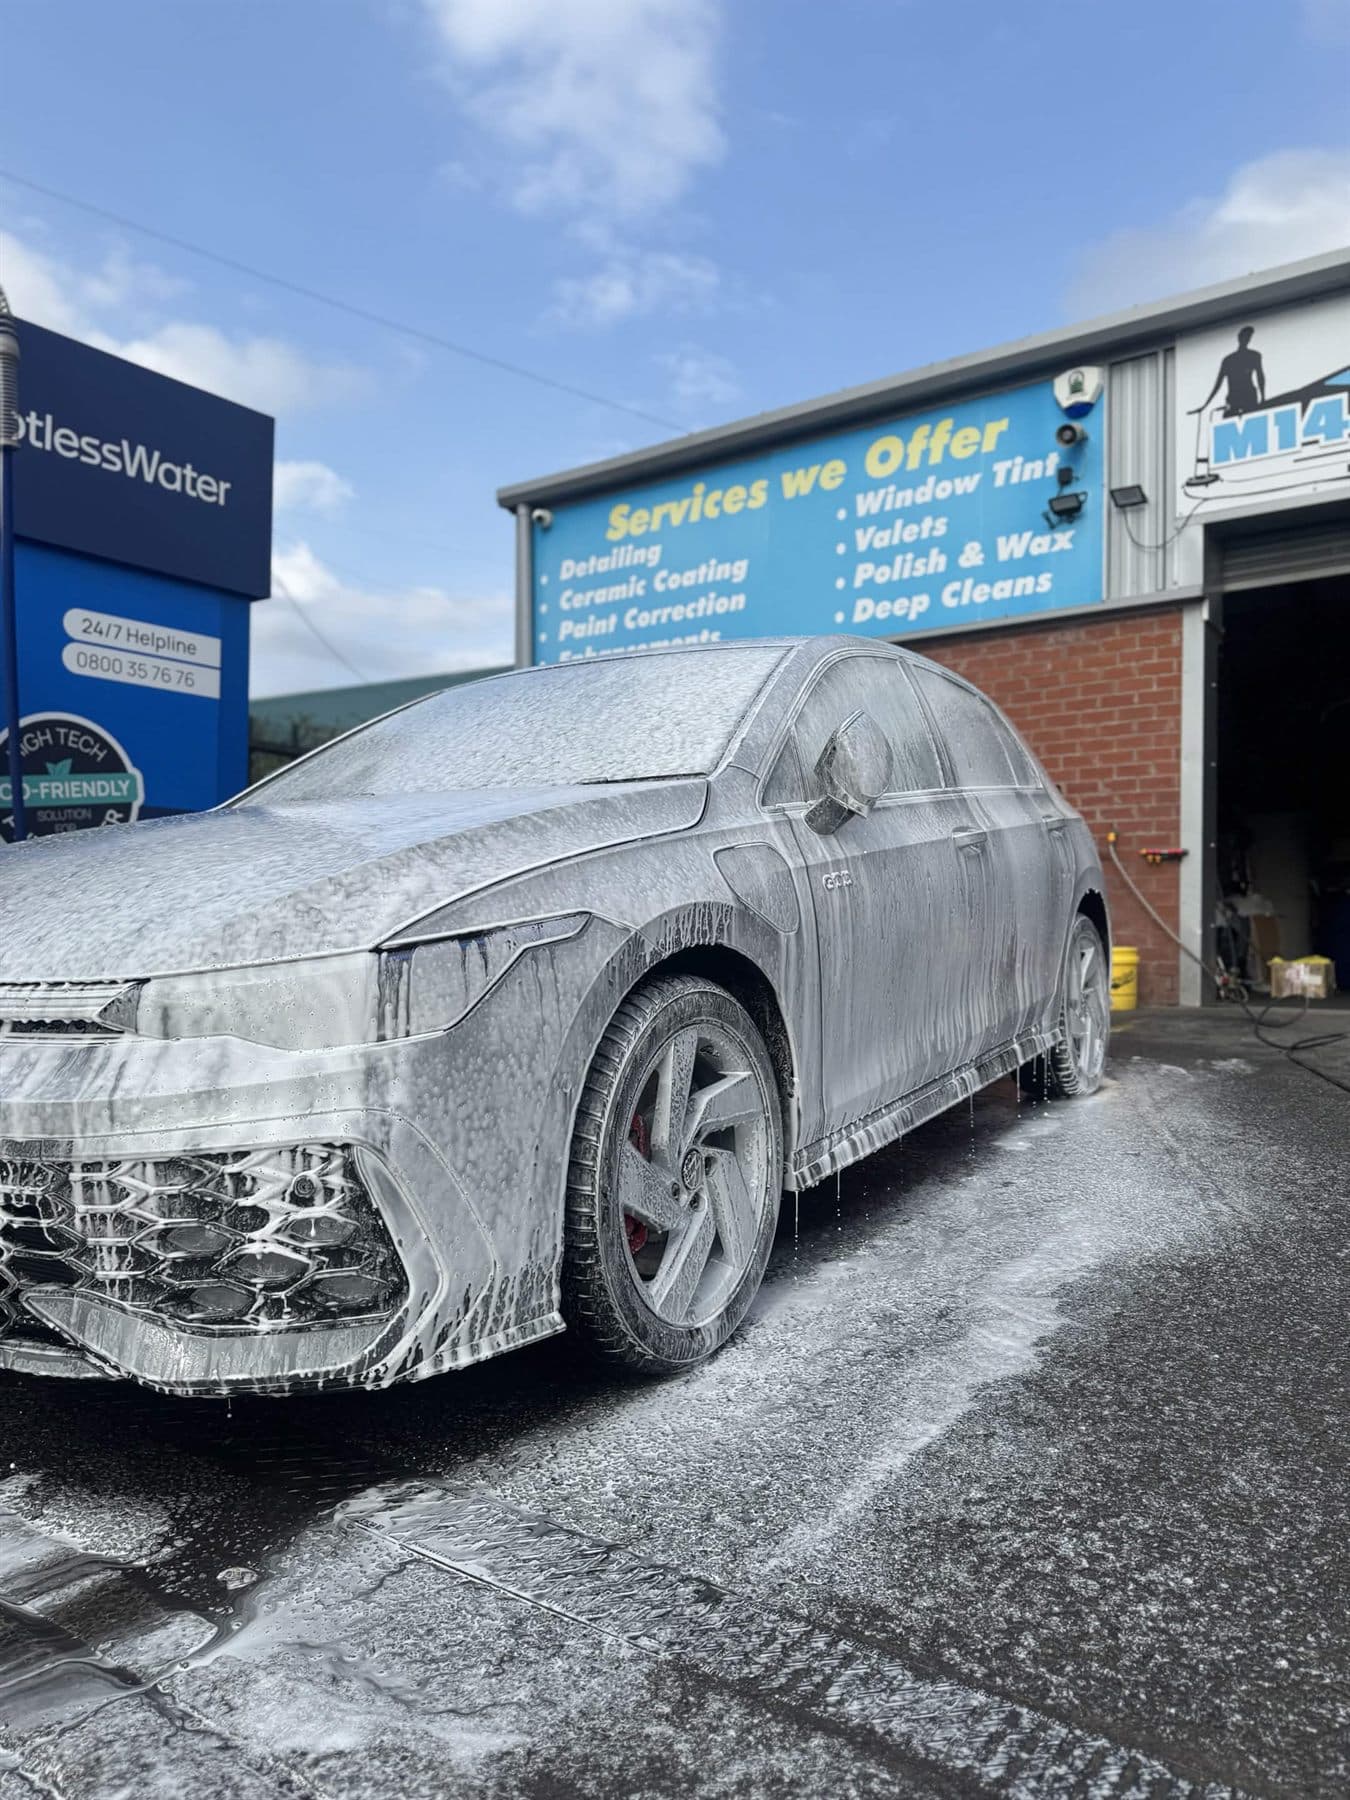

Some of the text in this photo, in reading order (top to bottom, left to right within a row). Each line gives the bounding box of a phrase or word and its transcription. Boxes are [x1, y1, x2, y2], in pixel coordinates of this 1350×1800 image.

[605, 418, 1009, 541] Services we Offer
[855, 452, 1060, 517] Window Tint
[854, 515, 948, 552] Valets
[559, 544, 662, 581] Detailing
[853, 529, 1076, 588] Polish & Wax
[559, 558, 749, 611] Ceramic Coating
[852, 572, 1054, 623] Deep Cleans
[81, 617, 197, 655] 24/7 Helpline
[558, 592, 746, 642] Paint Correction
[76, 651, 123, 674] 0800
[127, 660, 148, 680] 35
[55, 728, 108, 762] TECH
[37, 808, 92, 821] SOLUTION
